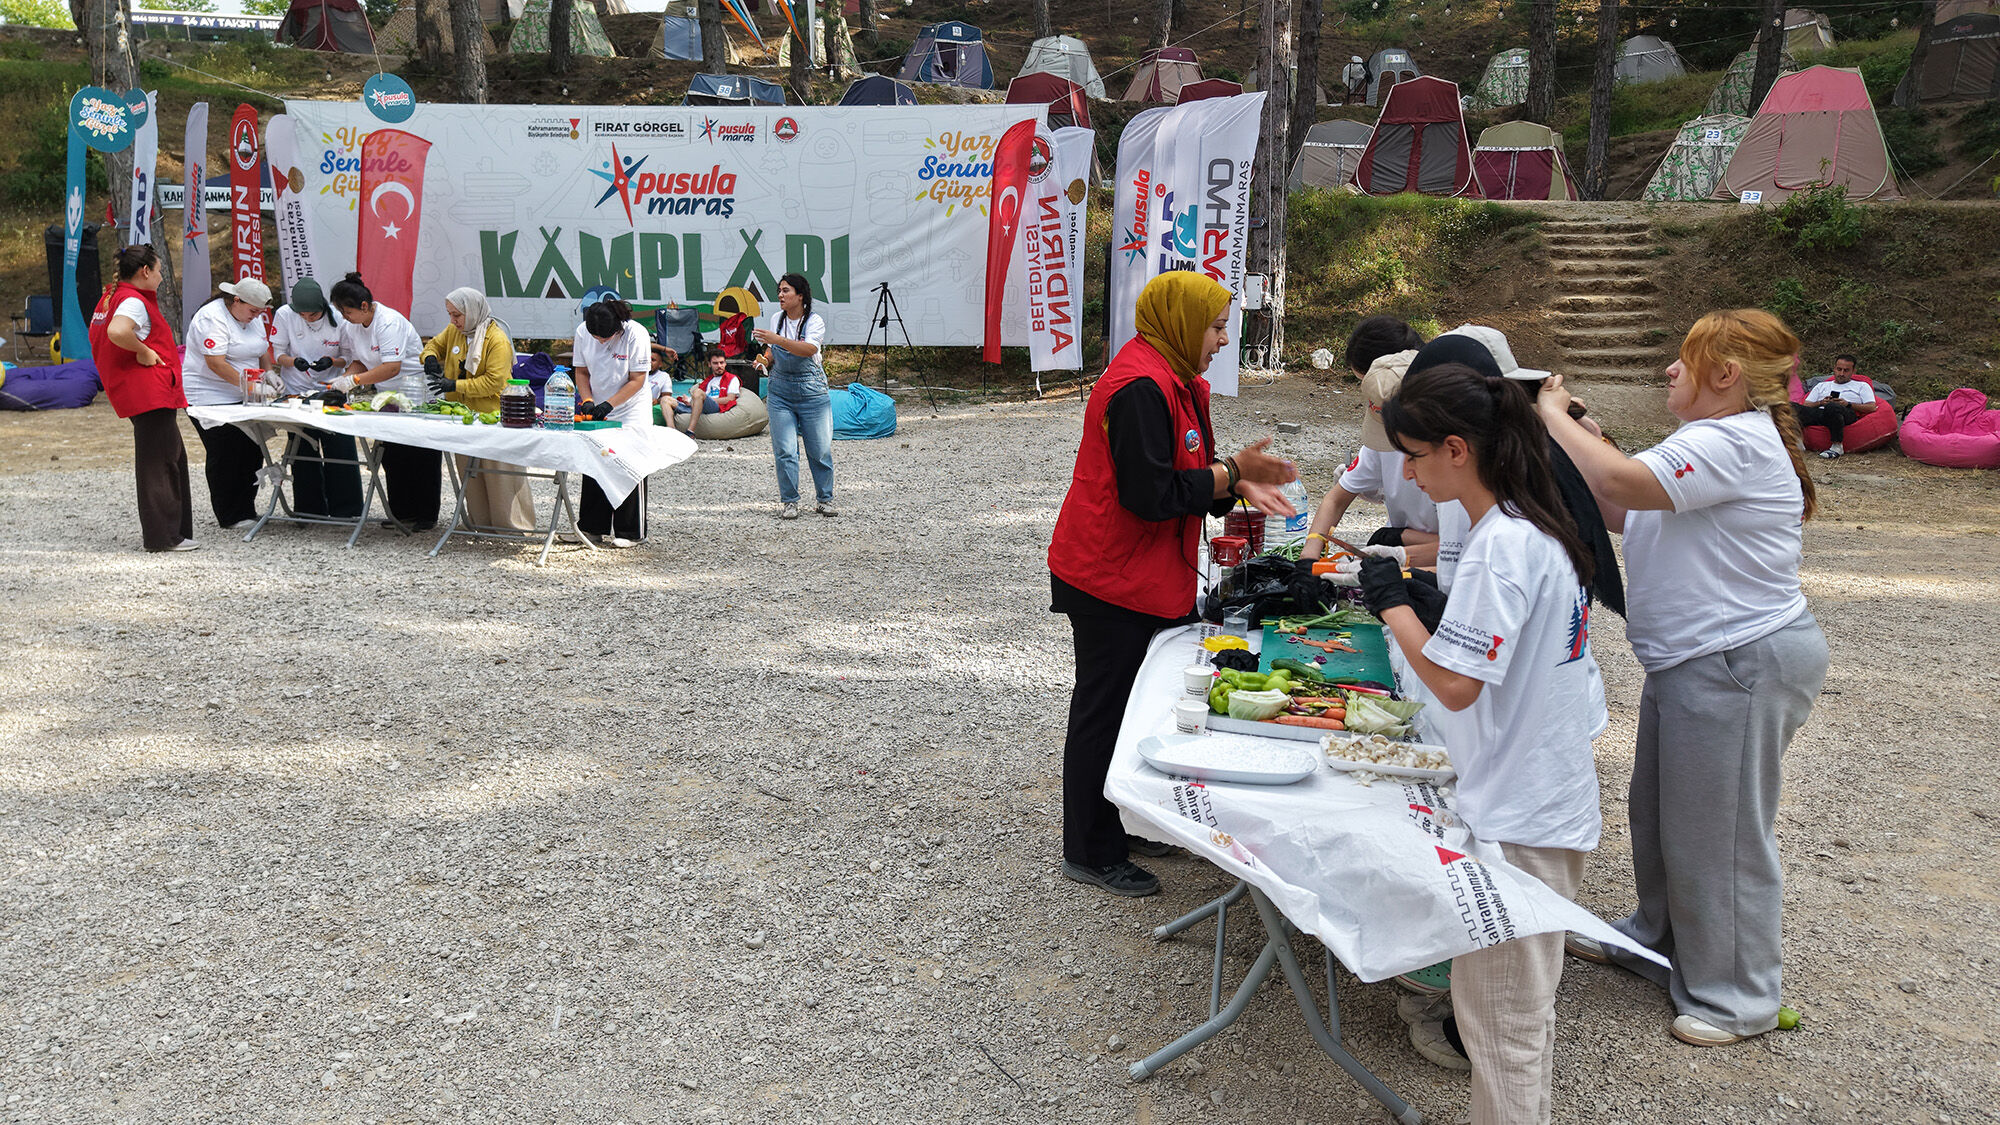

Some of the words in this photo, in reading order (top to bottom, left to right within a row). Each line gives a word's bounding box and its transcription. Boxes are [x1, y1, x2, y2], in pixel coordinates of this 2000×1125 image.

[182, 16, 198, 26] 24
[199, 18, 216, 27] AY
[719, 86, 731, 95] 38
[595, 122, 630, 132] FIRAT
[633, 121, 684, 132] GÖRGEL
[718, 122, 755, 138] pusula
[722, 133, 755, 143] maraş
[1706, 130, 1720, 139] 23
[939, 130, 1000, 161] Yaz
[918, 154, 1011, 181] Seninl
[190, 162, 199, 230] pusula
[332, 173, 394, 202] Güz
[633, 164, 737, 205] pusula
[1743, 192, 1760, 200] 33
[647, 196, 735, 219] maraş
[1133, 169, 1150, 237] pusula
[235, 185, 252, 280] DIRIN
[287, 202, 303, 280] manmaraş
[1159, 191, 1174, 274] FAD
[1230, 160, 1250, 301] KAHRAMANMARAŞ
[480, 225, 851, 304] KAMPLARI
[1440, 624, 1490, 650] Kahramanmaraş
